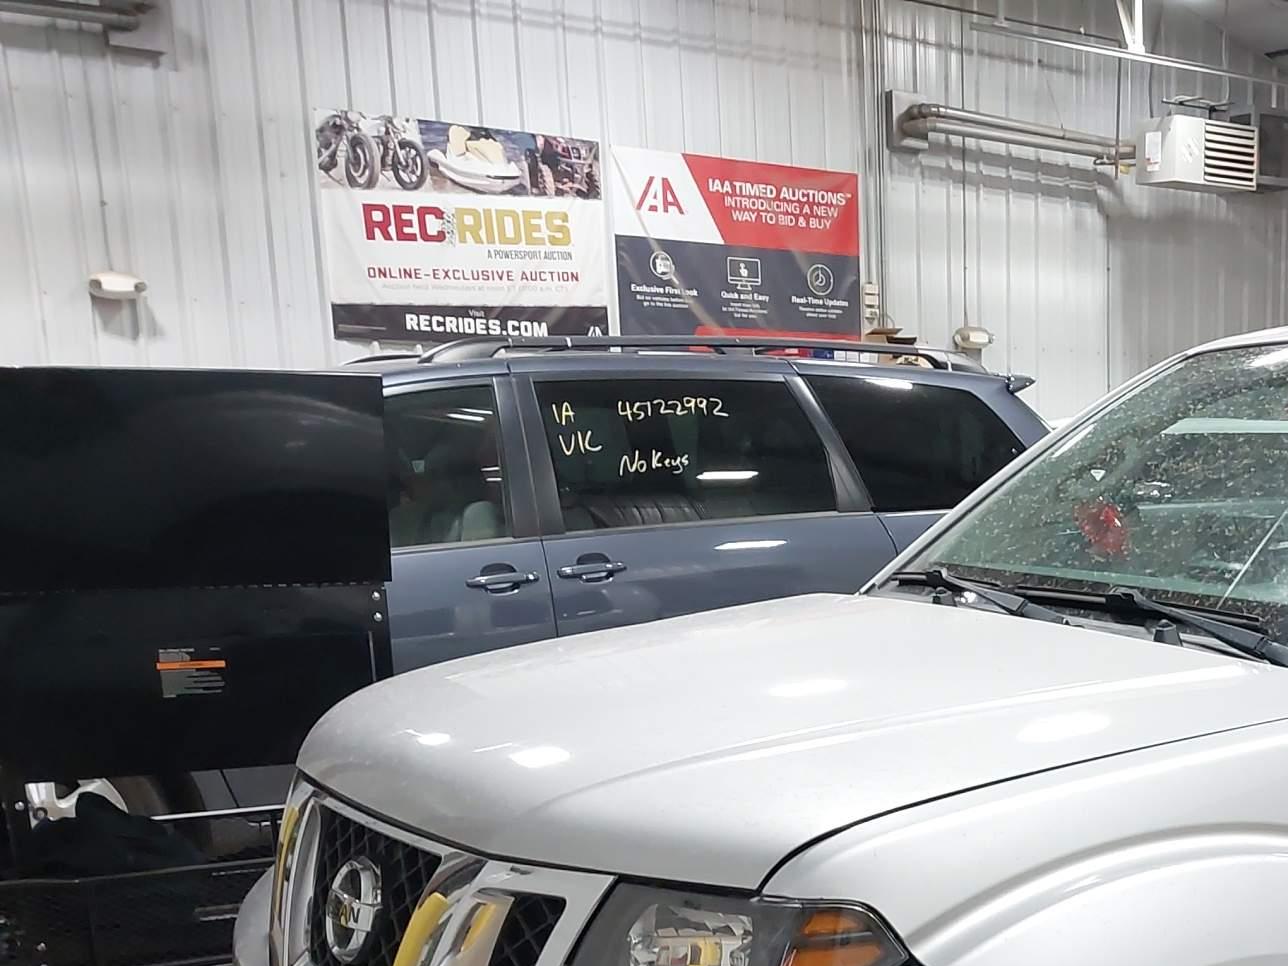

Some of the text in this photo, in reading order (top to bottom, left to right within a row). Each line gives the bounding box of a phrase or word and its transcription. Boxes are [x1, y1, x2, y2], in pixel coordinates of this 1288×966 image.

[708, 178, 731, 194] IAA
[733, 181, 776, 198] TIMED
[724, 196, 838, 218] INTRODUCING A NEW
[362, 203, 572, 246] REC RIDES
[731, 210, 832, 230] WAY TO BID & BUY
[487, 249, 573, 261] A POWERSPORT AUCTION
[367, 267, 579, 282] ONLINE-EXCLUSIVE AUCTION
[405, 313, 548, 337] RECRIDES.COM
